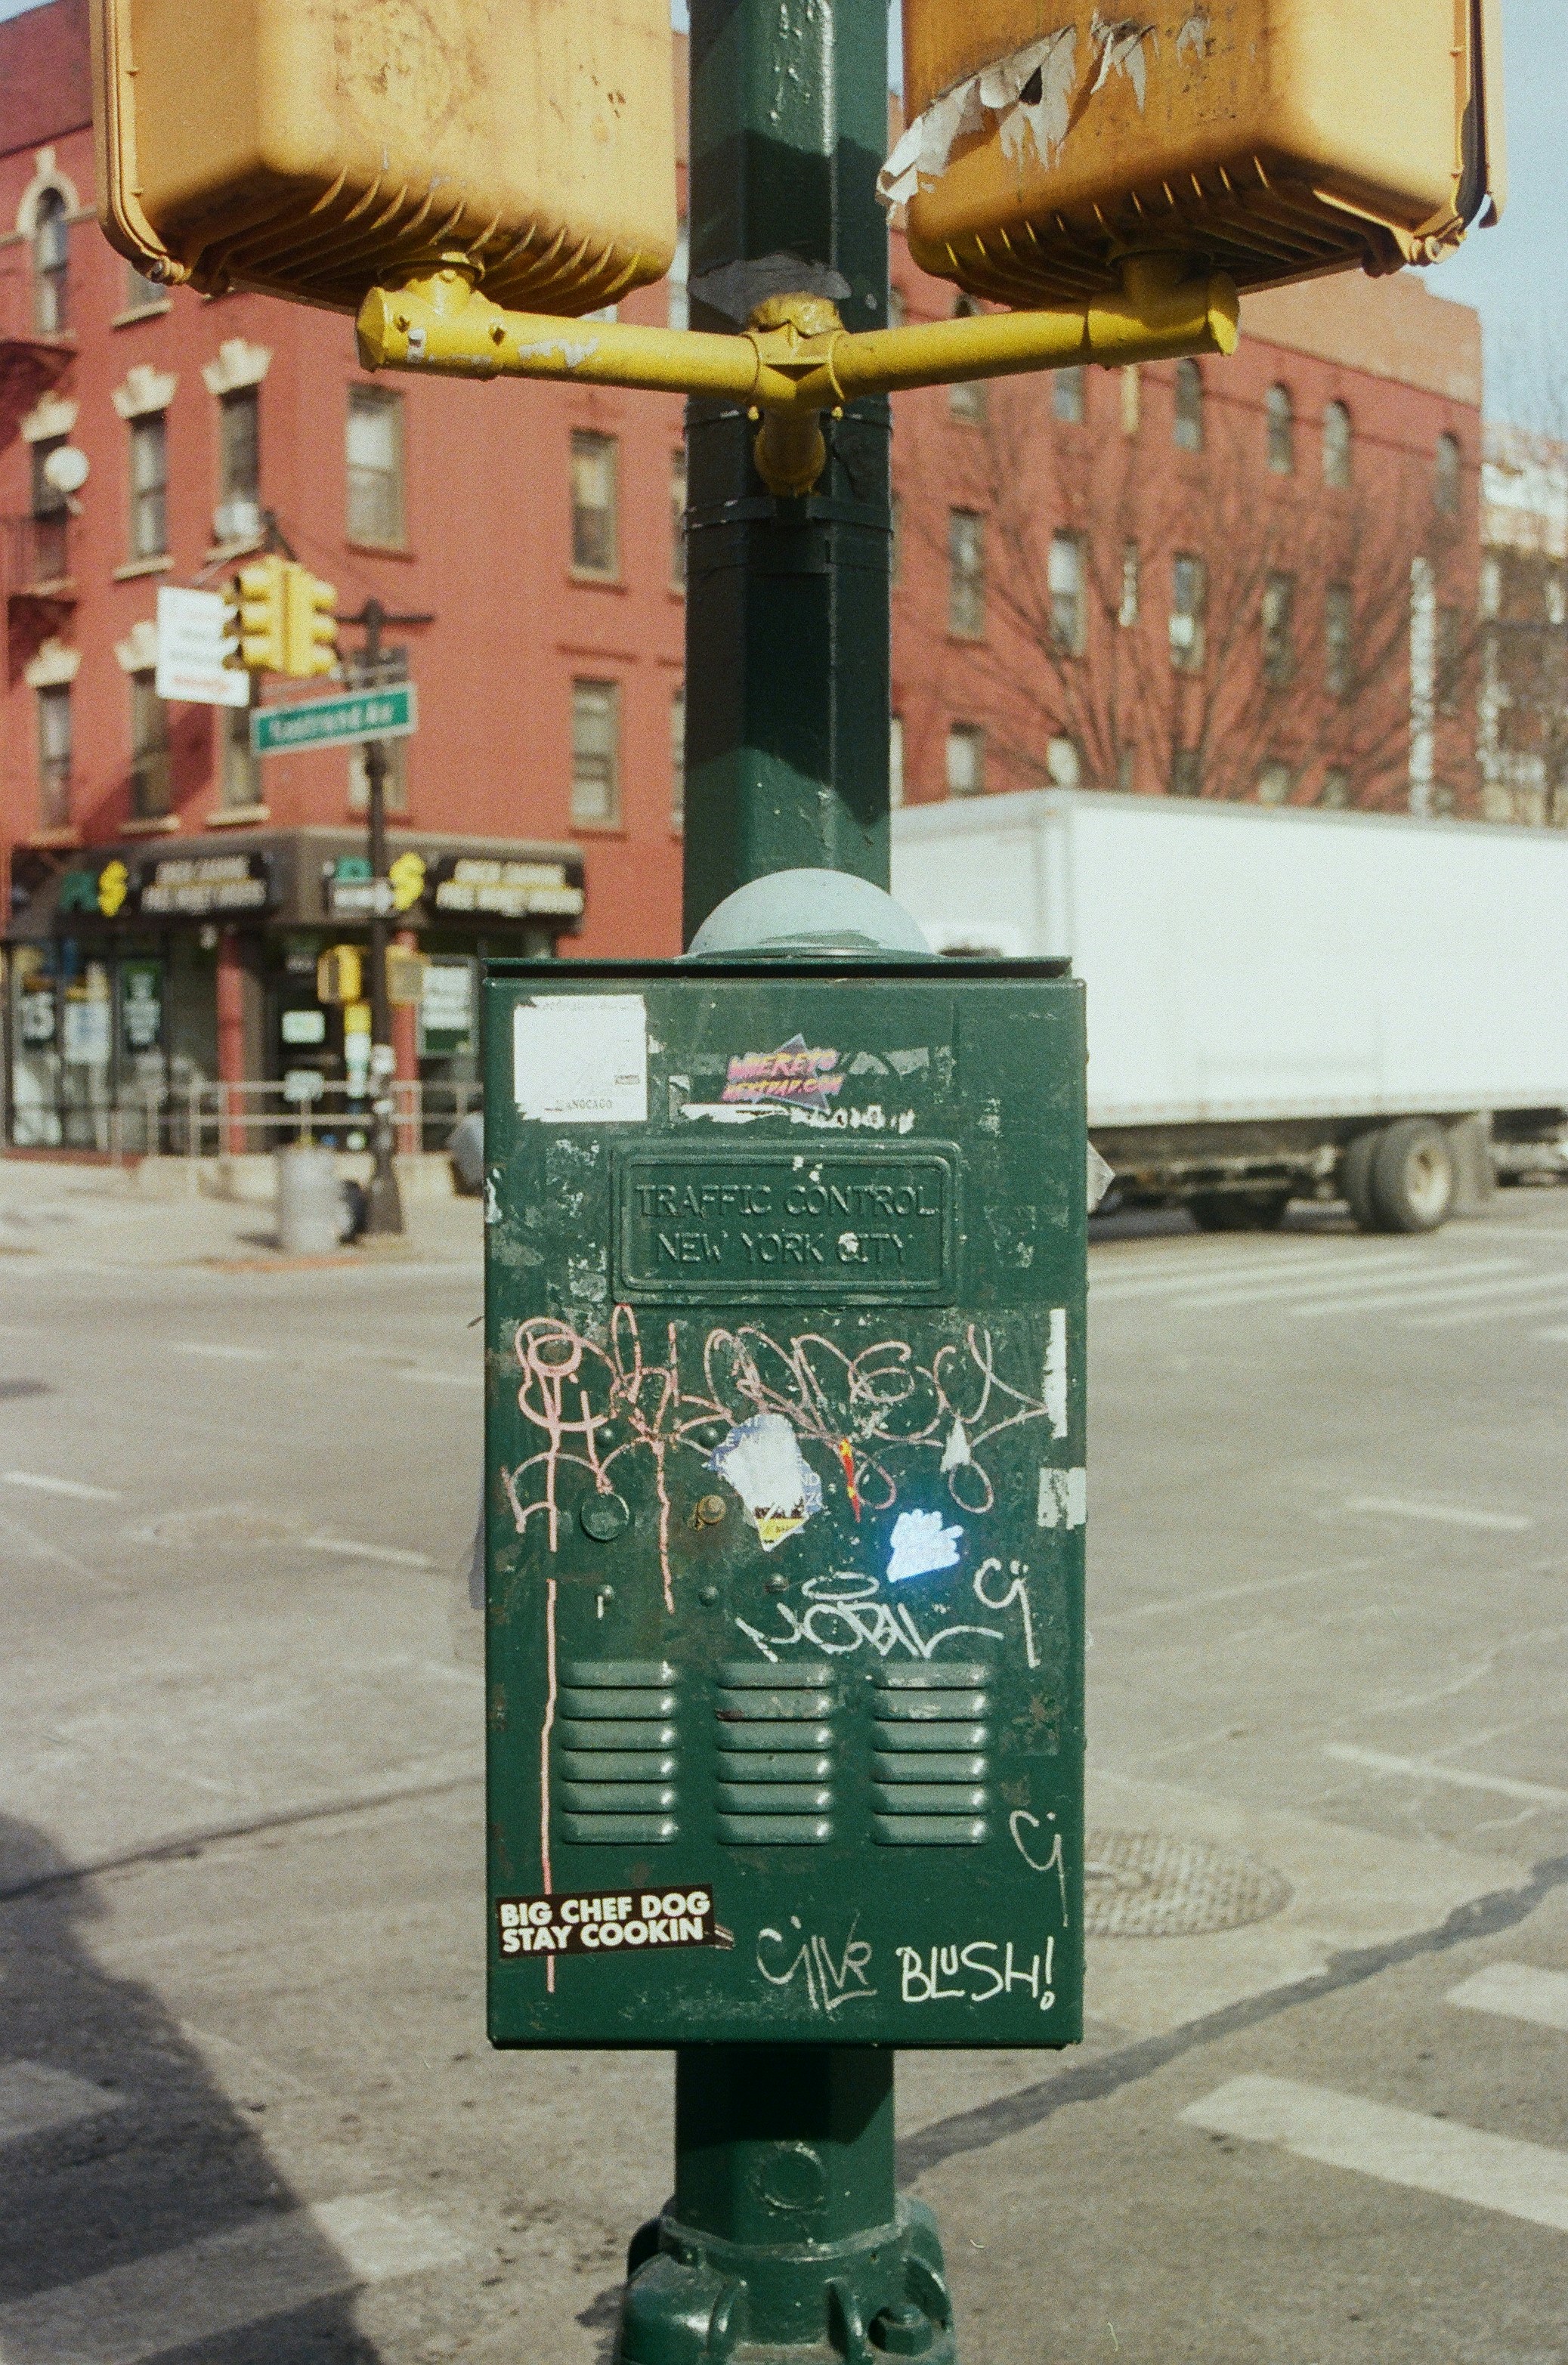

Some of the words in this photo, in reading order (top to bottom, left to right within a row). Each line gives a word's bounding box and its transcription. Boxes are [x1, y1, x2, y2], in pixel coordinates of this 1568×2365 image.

[636, 1184, 772, 1217] TRAFFIC
[785, 1184, 939, 1216] CONTROL
[657, 1231, 728, 1263] NEW
[740, 1231, 825, 1263] YORK
[837, 1231, 913, 1263] CITY
[500, 1900, 553, 1928] BIG
[560, 1896, 632, 1924] CHEF
[640, 1890, 711, 1919] DOG
[503, 1924, 572, 1953] STAY
[580, 1917, 704, 1948] COOKIN
